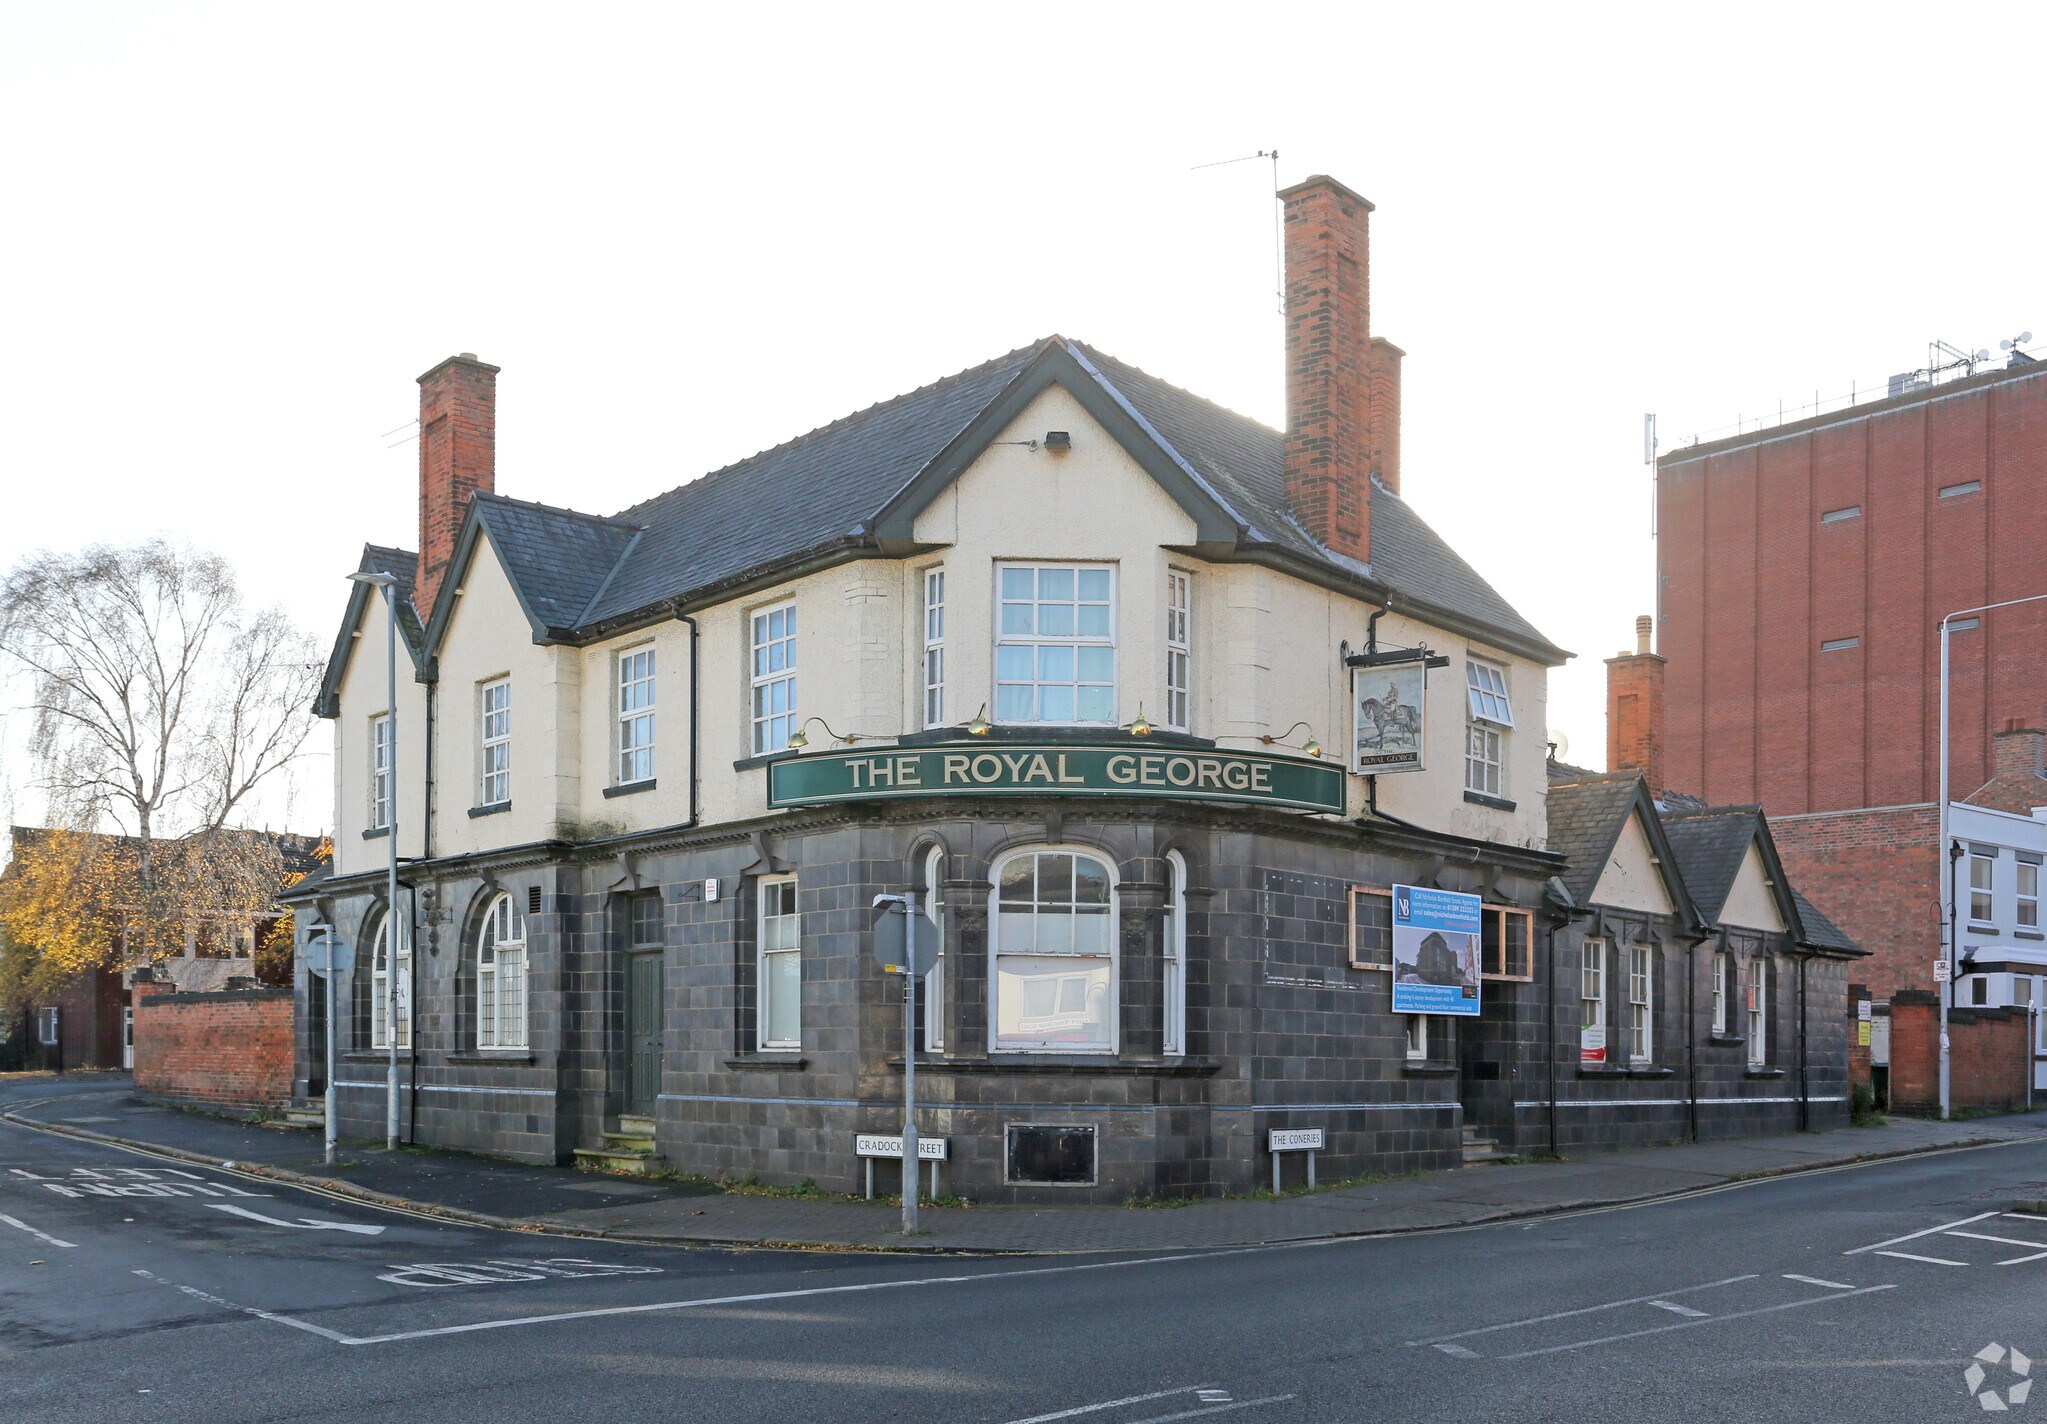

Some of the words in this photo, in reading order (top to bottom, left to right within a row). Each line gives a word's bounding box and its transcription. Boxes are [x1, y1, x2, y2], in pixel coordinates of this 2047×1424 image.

[1387, 753, 1414, 762] GEORGE
[845, 754, 921, 788] THE
[943, 753, 1084, 784] ROYAL
[1106, 755, 1273, 794] GEORGE
[1273, 1135, 1286, 1145] THE
[1289, 1133, 1320, 1144] CONERIES
[859, 1140, 903, 1152] CRADOCK
[918, 1143, 942, 1154] REET
[9, 1168, 204, 1181] LEFT
[43, 1182, 274, 1198] TURN
[376, 1258, 664, 1287] STOP
